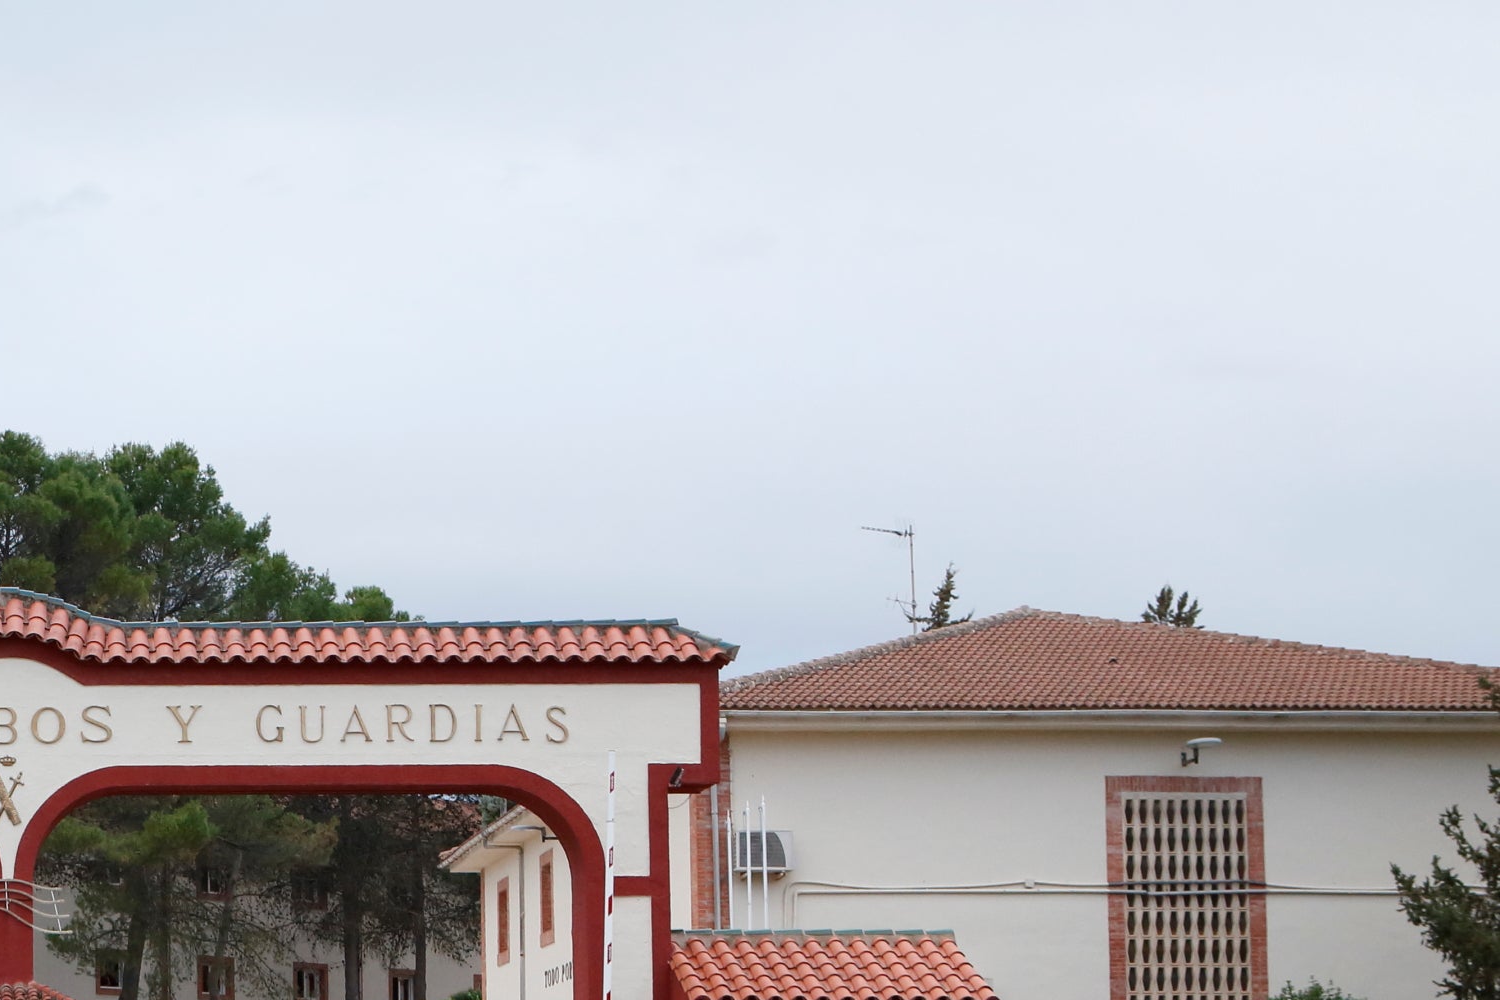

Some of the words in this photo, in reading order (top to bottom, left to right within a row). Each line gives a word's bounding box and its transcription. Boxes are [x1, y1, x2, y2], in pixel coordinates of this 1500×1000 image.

[166, 704, 203, 743] Y
[255, 703, 570, 744] GUARDIAS
[544, 965, 560, 989] TODO
